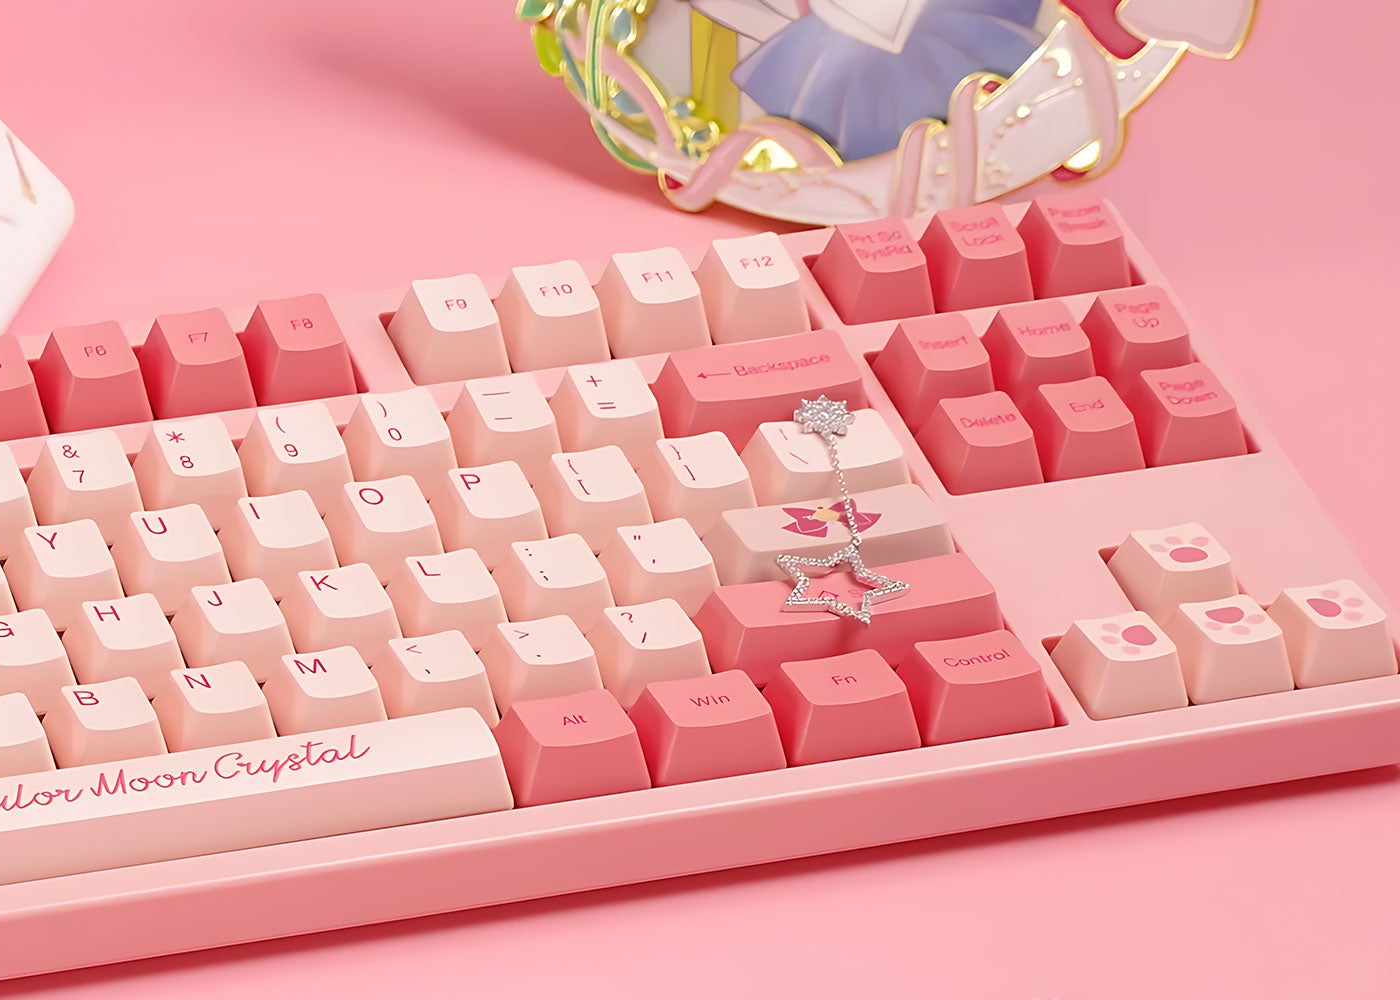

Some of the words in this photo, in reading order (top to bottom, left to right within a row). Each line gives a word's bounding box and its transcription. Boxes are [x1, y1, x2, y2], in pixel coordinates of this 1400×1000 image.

[739, 255, 774, 270] F12
[641, 270, 674, 283] F11
[538, 283, 573, 297] F10
[444, 298, 468, 311] F9
[290, 318, 314, 331] F8
[1017, 322, 1072, 336] Home
[187, 331, 209, 344] F7
[83, 344, 107, 358] F6
[733, 354, 831, 377] Backspace
[585, 375, 603, 388] +
[596, 401, 617, 410] =
[1069, 398, 1105, 413] End
[959, 412, 1017, 428] Delete
[387, 427, 403, 442] 0
[61, 444, 80, 459] &
[283, 443, 299, 458] 9
[179, 455, 194, 469] 8
[72, 469, 85, 484] 7
[459, 473, 481, 491] P
[358, 487, 384, 506] O
[248, 502, 261, 520] I
[141, 516, 168, 535] U
[36, 531, 58, 550] Y
[416, 560, 442, 577] L
[309, 574, 338, 591] K
[207, 590, 223, 607] J
[93, 605, 121, 622] H
[620, 611, 634, 624] ?
[943, 648, 1011, 668] Control
[293, 658, 328, 675] M
[183, 673, 212, 690] N
[830, 673, 858, 686] Fn
[72, 690, 100, 706] B
[689, 695, 731, 707] Win
[563, 714, 588, 726] Alt
[89, 768, 208, 797] Moon
[213, 733, 372, 784] Crystal
